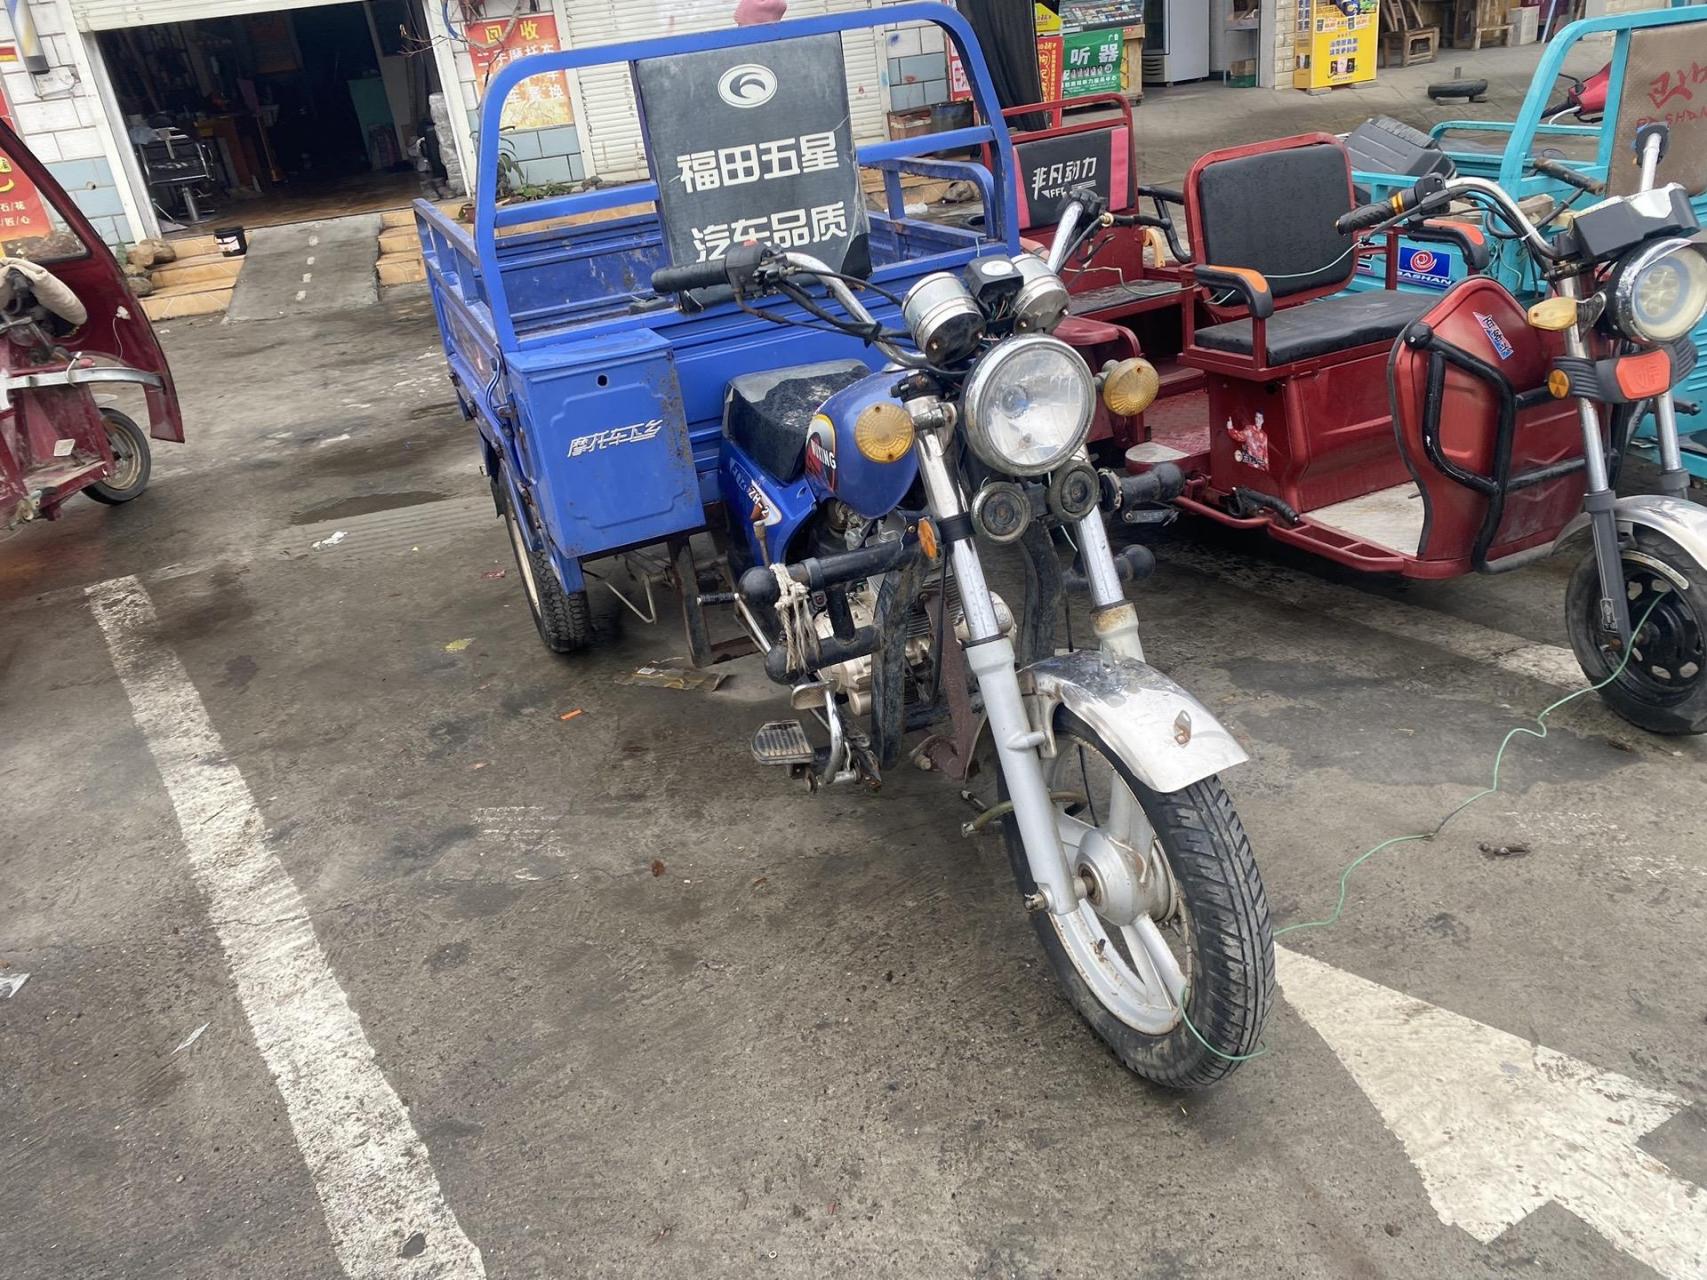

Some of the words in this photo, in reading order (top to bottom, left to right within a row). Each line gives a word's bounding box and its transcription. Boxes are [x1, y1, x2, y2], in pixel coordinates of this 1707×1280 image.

[484, 20, 539, 44] 回收
[676, 131, 839, 193] 福田五星
[1031, 157, 1097, 201] 非凡动力
[691, 201, 847, 263] 汽车品质
